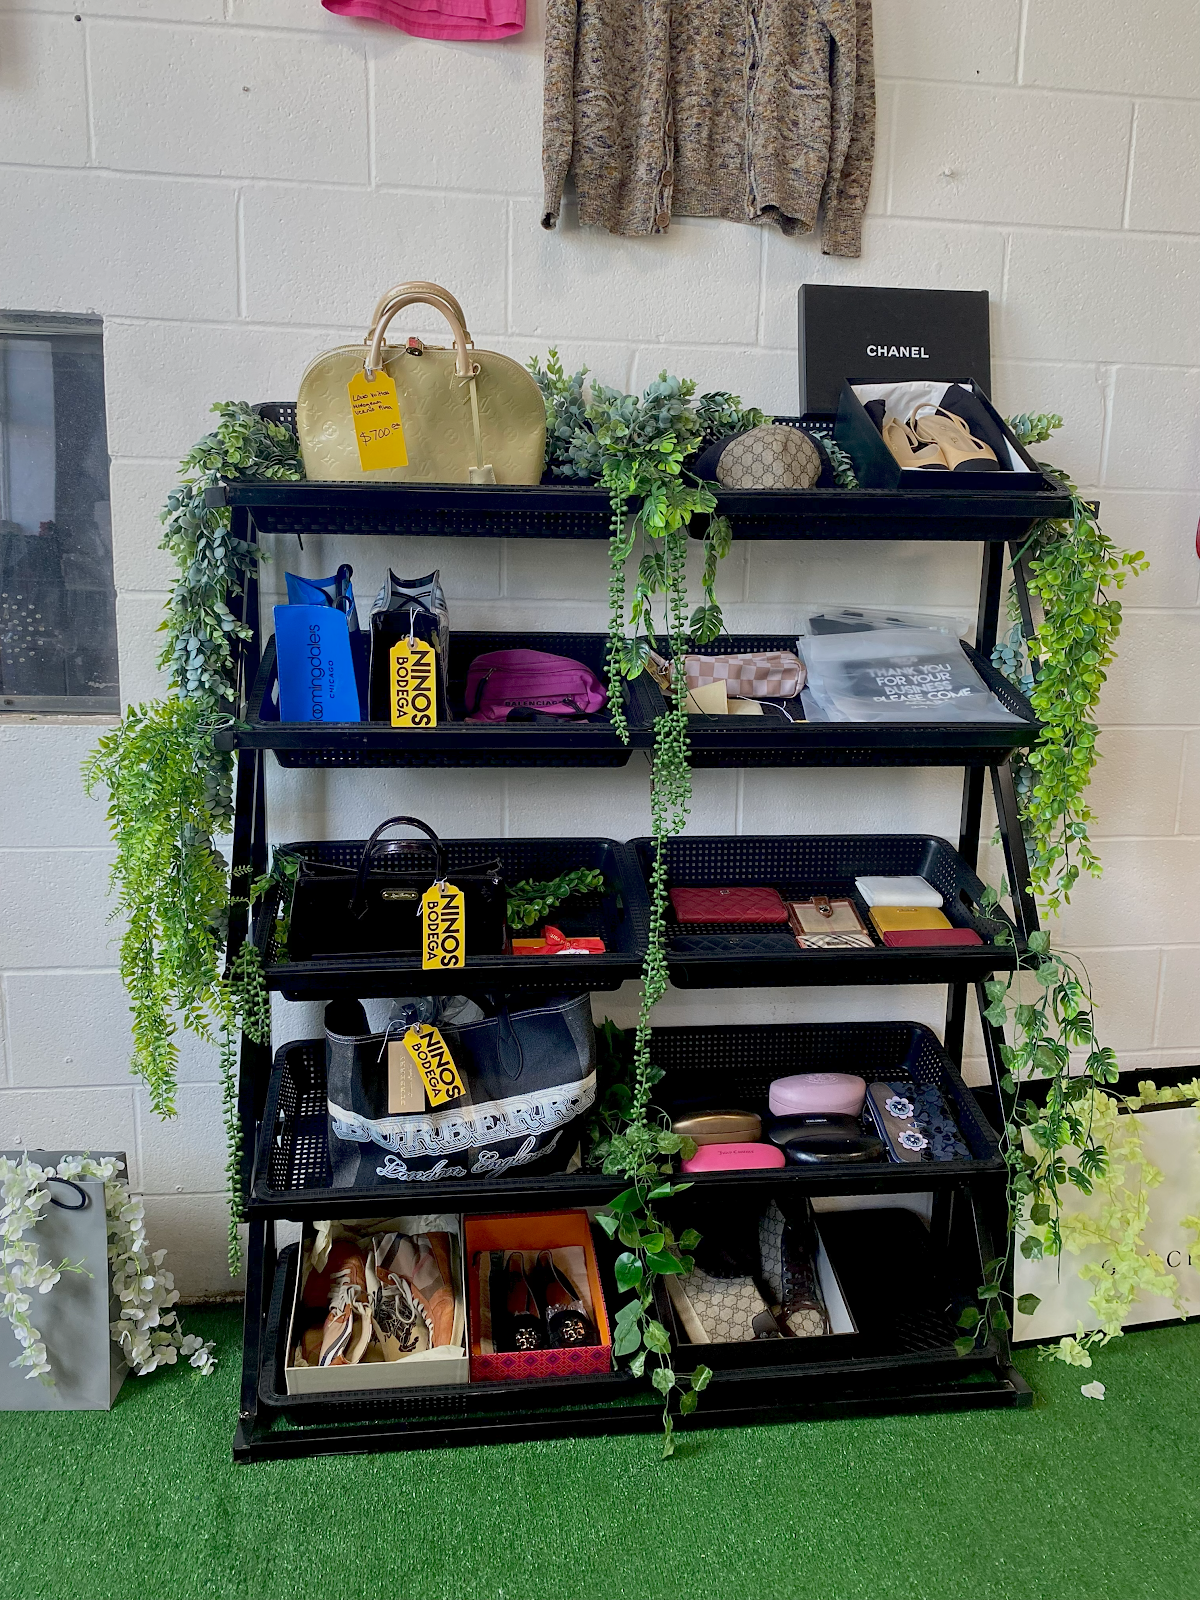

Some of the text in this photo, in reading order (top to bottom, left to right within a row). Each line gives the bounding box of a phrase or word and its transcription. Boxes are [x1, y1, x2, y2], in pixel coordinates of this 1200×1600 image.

[866, 344, 930, 359] CHANEL
[306, 624, 326, 722] loomingdale's
[327, 660, 335, 699] CHICAGO
[396, 656, 409, 719] BODEGA
[410, 650, 432, 726] NINOS
[866, 663, 952, 678] THANK YOU
[875, 672, 952, 687] FOR YOUR
[884, 680, 952, 695] BUSINESS
[927, 687, 974, 700] COME
[427, 901, 440, 962] BODEGA
[440, 894, 460, 967] NINOS
[411, 1042, 443, 1099] BODEGA
[419, 1030, 462, 1099] NINOS
